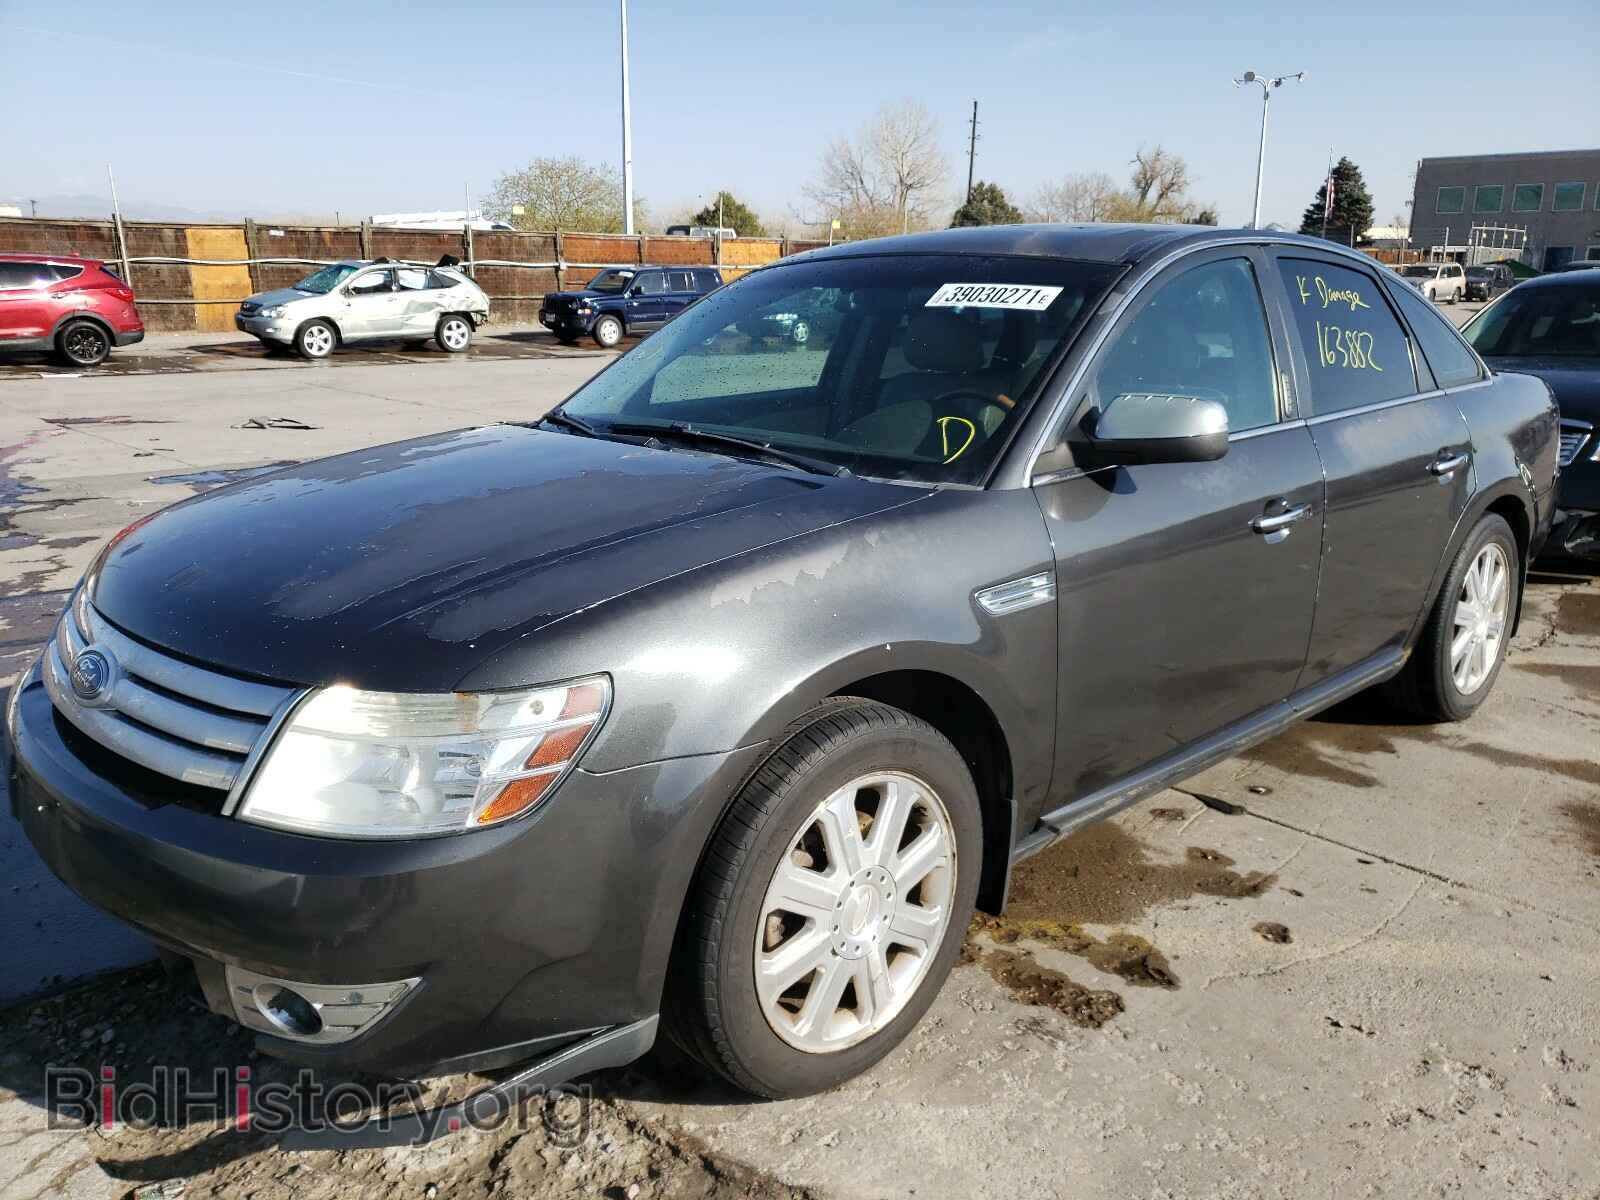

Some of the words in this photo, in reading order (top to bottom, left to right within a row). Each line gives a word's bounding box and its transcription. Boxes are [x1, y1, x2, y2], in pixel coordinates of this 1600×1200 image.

[945, 286, 1041, 305] 39030271
[1315, 276, 1371, 311] Damage
[1316, 320, 1383, 371] 163882
[936, 416, 976, 464] D
